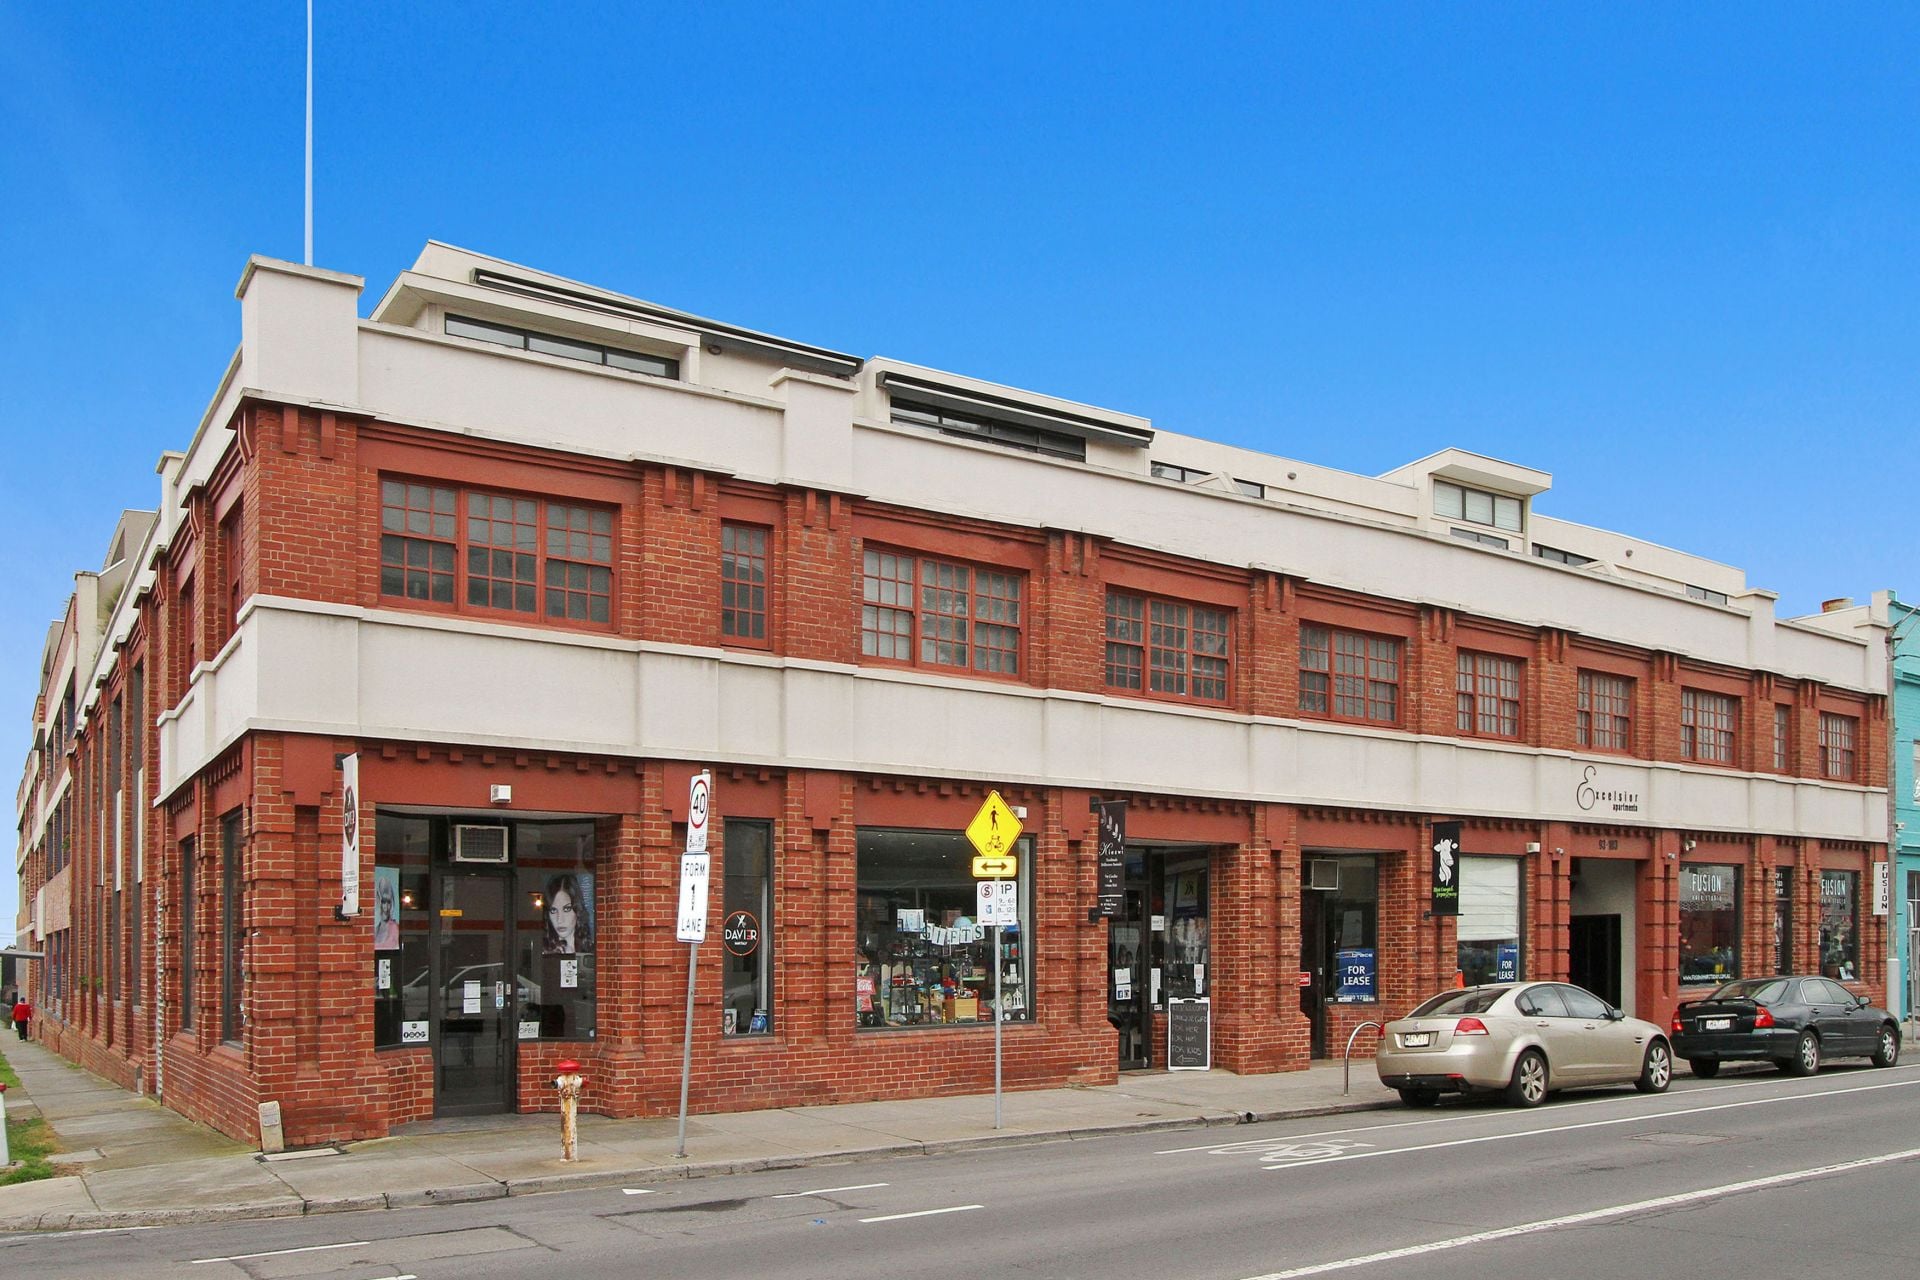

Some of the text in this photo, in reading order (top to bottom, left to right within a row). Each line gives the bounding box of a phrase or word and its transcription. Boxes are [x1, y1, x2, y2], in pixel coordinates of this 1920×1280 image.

[1576, 765, 1638, 811] Excelsior
[692, 793, 706, 814] 40
[1612, 802, 1638, 812] apartments
[684, 862, 706, 877] FORM
[1000, 883, 1013, 895] 1P
[1692, 873, 1722, 892] FUSION
[1820, 879, 1846, 896] FUSION
[1880, 864, 1888, 910] FUSION
[690, 883, 696, 911] 1
[681, 918, 702, 933] LANE
[922, 924, 982, 944] GIFTS
[1347, 965, 1366, 975] FOR
[1501, 960, 1513, 969] FOR
[1343, 976, 1371, 986] LEASE
[1498, 970, 1515, 980] LEASE
[519, 1027, 537, 1036] OPEN
